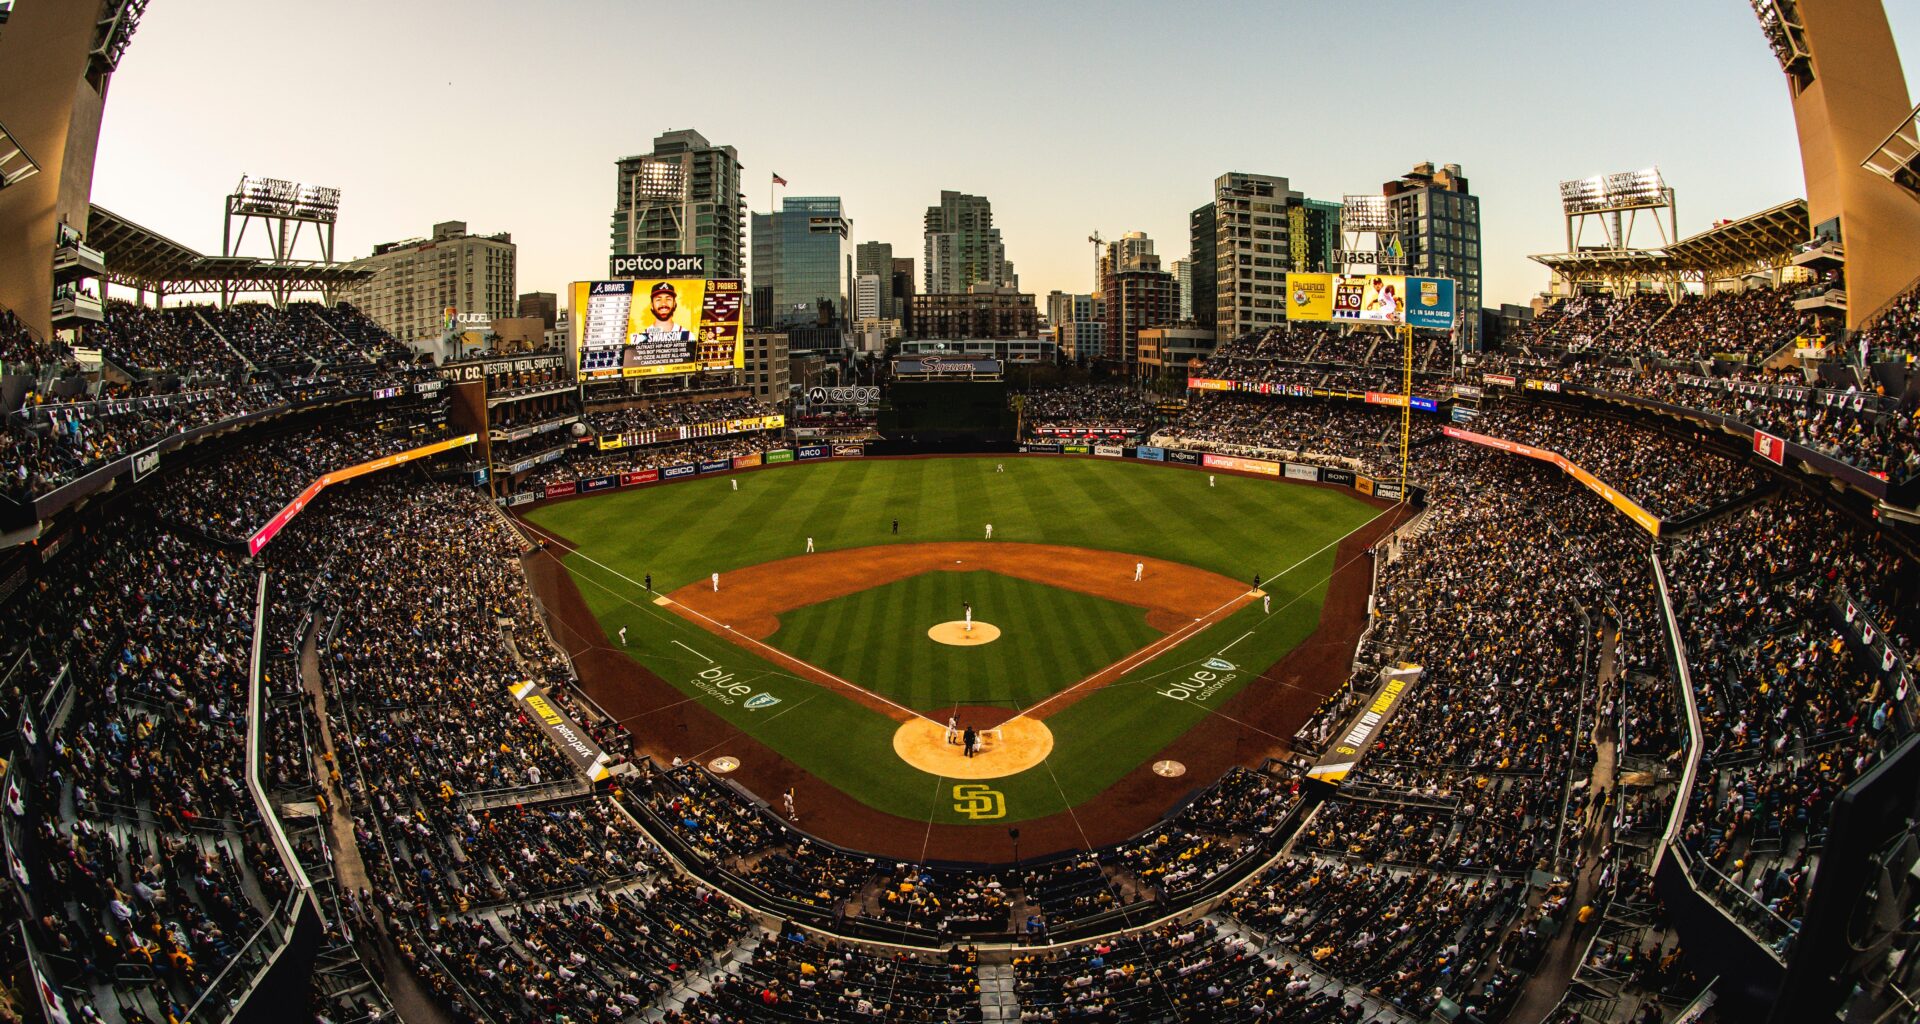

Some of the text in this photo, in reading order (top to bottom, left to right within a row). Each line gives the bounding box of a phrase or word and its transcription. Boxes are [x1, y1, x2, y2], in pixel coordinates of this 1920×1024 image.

[1332, 251, 1382, 264] Viasat
[615, 256, 703, 274] petco park
[604, 284, 624, 292] BRAVES
[648, 331, 682, 342] SWANSON
[484, 357, 564, 374] WESTERN METAL SUPPLY CO.
[920, 356, 976, 375] Sycuan
[465, 366, 482, 379] CO.
[420, 381, 441, 392] CUTWATER
[1194, 380, 1220, 388] illumina
[831, 385, 880, 406] edge
[1372, 394, 1402, 404] illumina
[800, 448, 820, 457] ARCO
[736, 457, 760, 466] illumina
[1205, 456, 1232, 466] illumina
[631, 473, 657, 482] Snapdragon
[665, 466, 694, 476] GEICO
[548, 486, 574, 495] Budweiser
[1377, 489, 1402, 499] HOMERS
[698, 666, 751, 695] blue
[1157, 671, 1216, 700] blue
[1196, 674, 1236, 700] california
[691, 679, 734, 705] california
[1344, 679, 1406, 746] THANK YOU PADRES FANS
[552, 724, 593, 758] petco park
[953, 784, 1006, 819] SD
